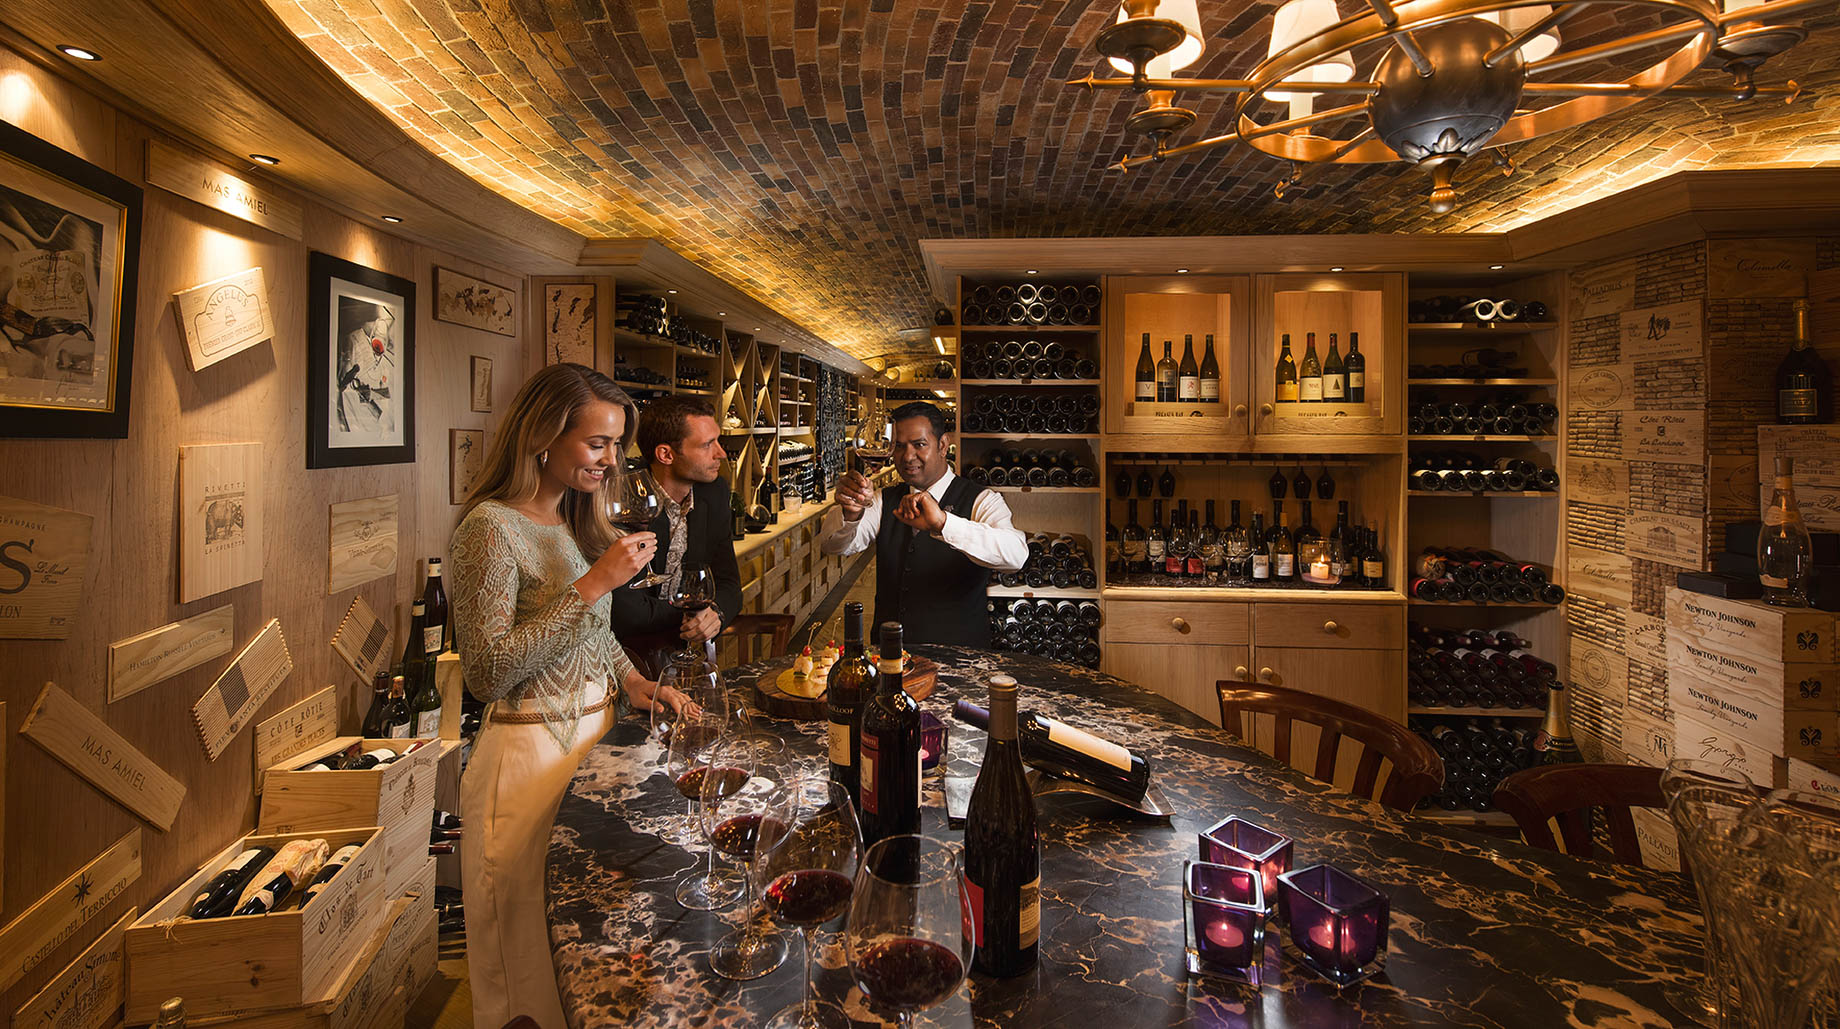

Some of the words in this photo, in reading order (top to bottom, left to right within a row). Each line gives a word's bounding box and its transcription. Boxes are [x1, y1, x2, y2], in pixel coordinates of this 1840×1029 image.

[202, 176, 231, 199] MAS
[235, 193, 268, 216] AMIEL
[206, 288, 249, 320] ANGELUS
[205, 481, 246, 493] RIVETTI
[1685, 602, 1717, 618] NEWTON
[1718, 611, 1757, 629] JOHNSON
[1715, 622, 1747, 637] Vineyards
[1686, 644, 1718, 661] NEWTON
[1719, 655, 1758, 675] JOHNSON
[1716, 665, 1747, 683] Vineyards
[1688, 687, 1719, 706] NEWTON
[1720, 699, 1758, 721] JOHNSON
[81, 735, 112, 765] MAS
[111, 758, 147, 792] AMIEL
[22, 931, 64, 974] CASTELLO
[64, 919, 79, 938] DEL
[80, 877, 128, 923] TERRICCIO
